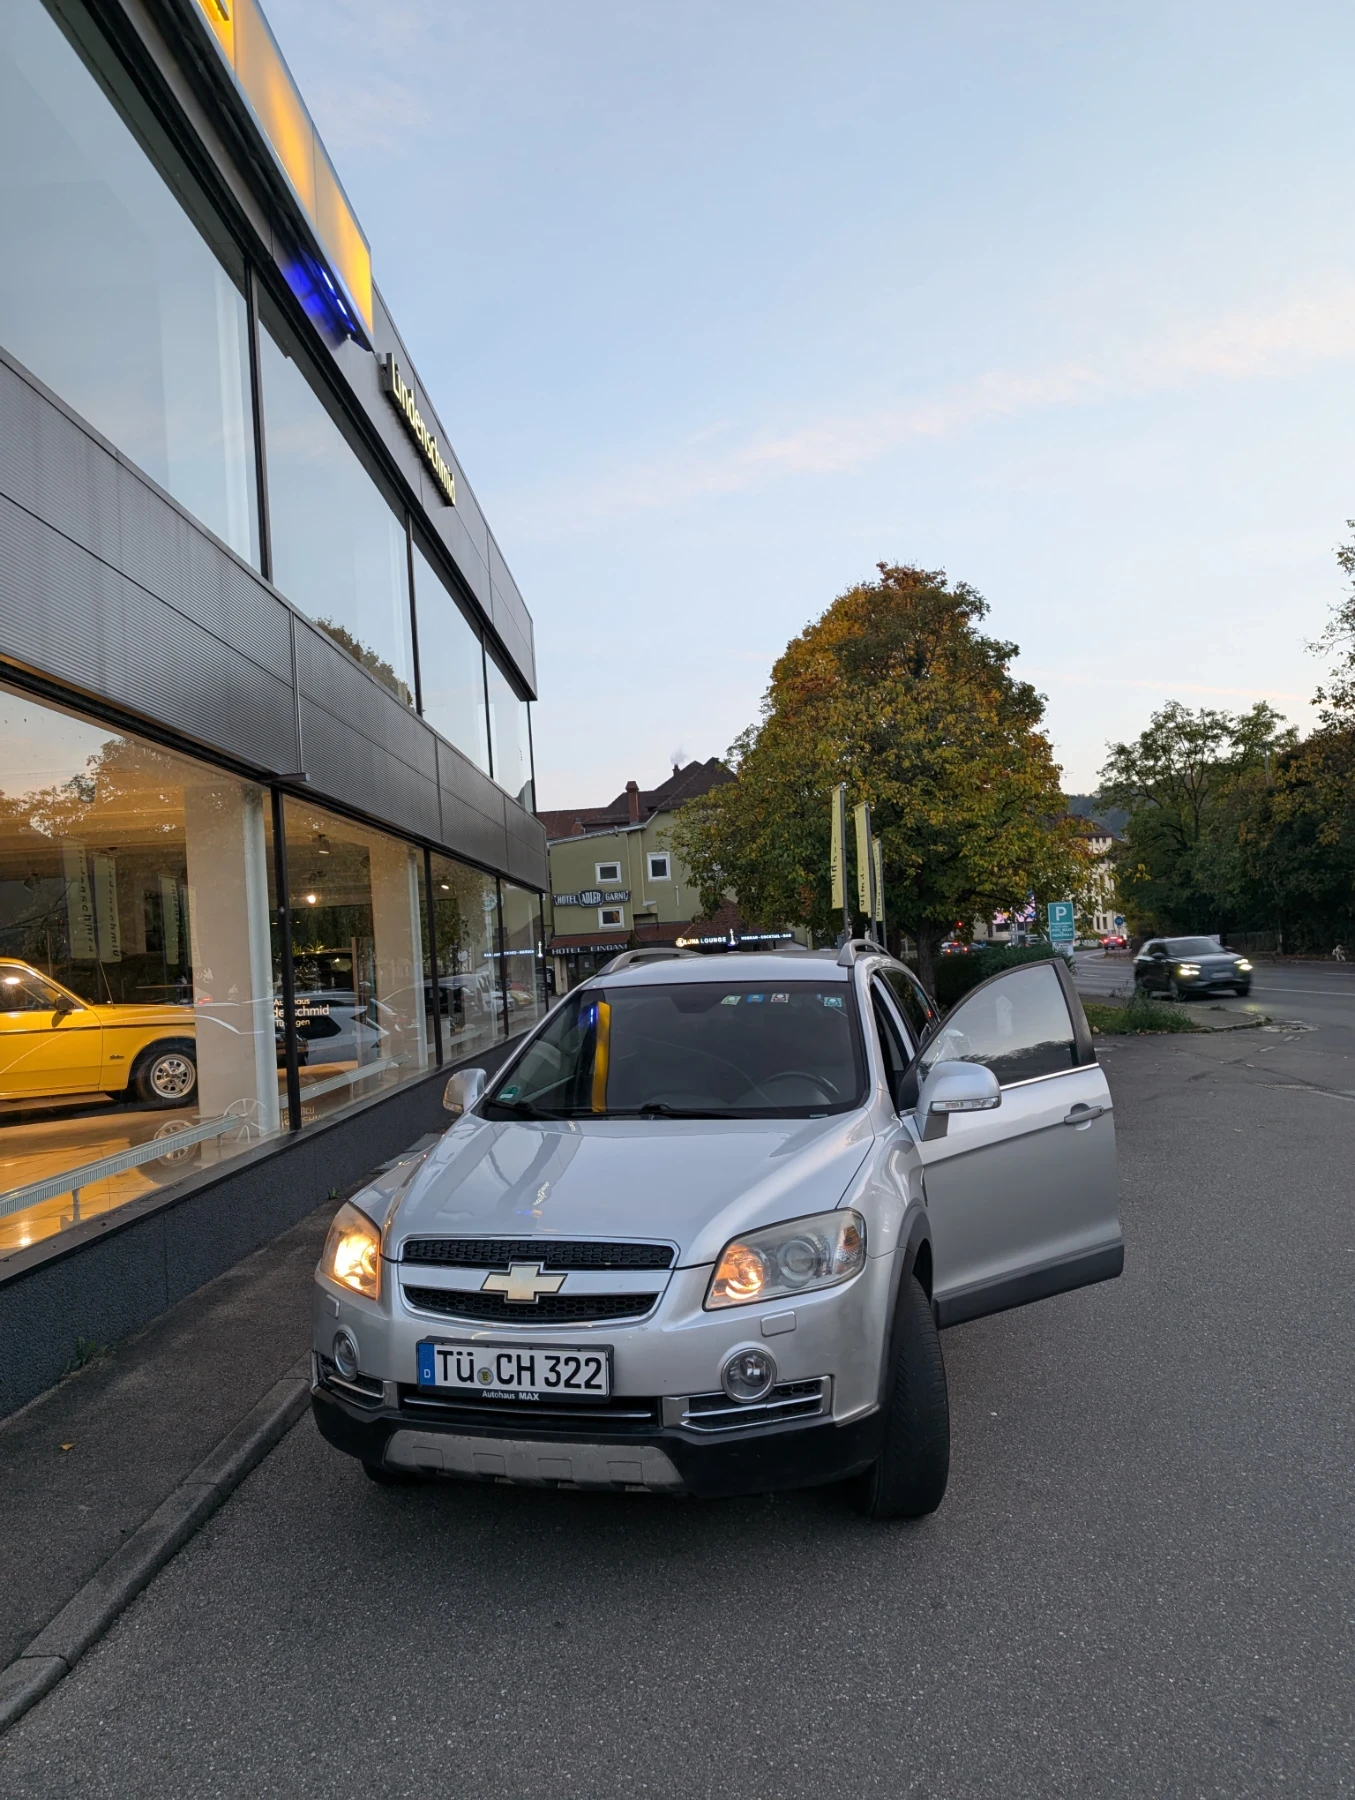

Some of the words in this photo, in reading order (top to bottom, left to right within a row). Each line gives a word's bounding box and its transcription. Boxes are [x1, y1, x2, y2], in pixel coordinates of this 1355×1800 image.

[385, 352, 456, 508] Lindenschmid
[78, 843, 94, 953] indenschmid
[557, 895, 578, 905] HOTEL
[581, 891, 601, 904] ADLER
[605, 891, 626, 901] GARNI
[1055, 906, 1067, 921] P
[700, 936, 727, 944] LOUNGE
[423, 1368, 431, 1378] D
[436, 1350, 475, 1383] TÜ
[496, 1353, 536, 1386] CH
[544, 1356, 603, 1390] 322
[482, 1390, 515, 1400] Autohaus
[518, 1391, 540, 1401] MAX
